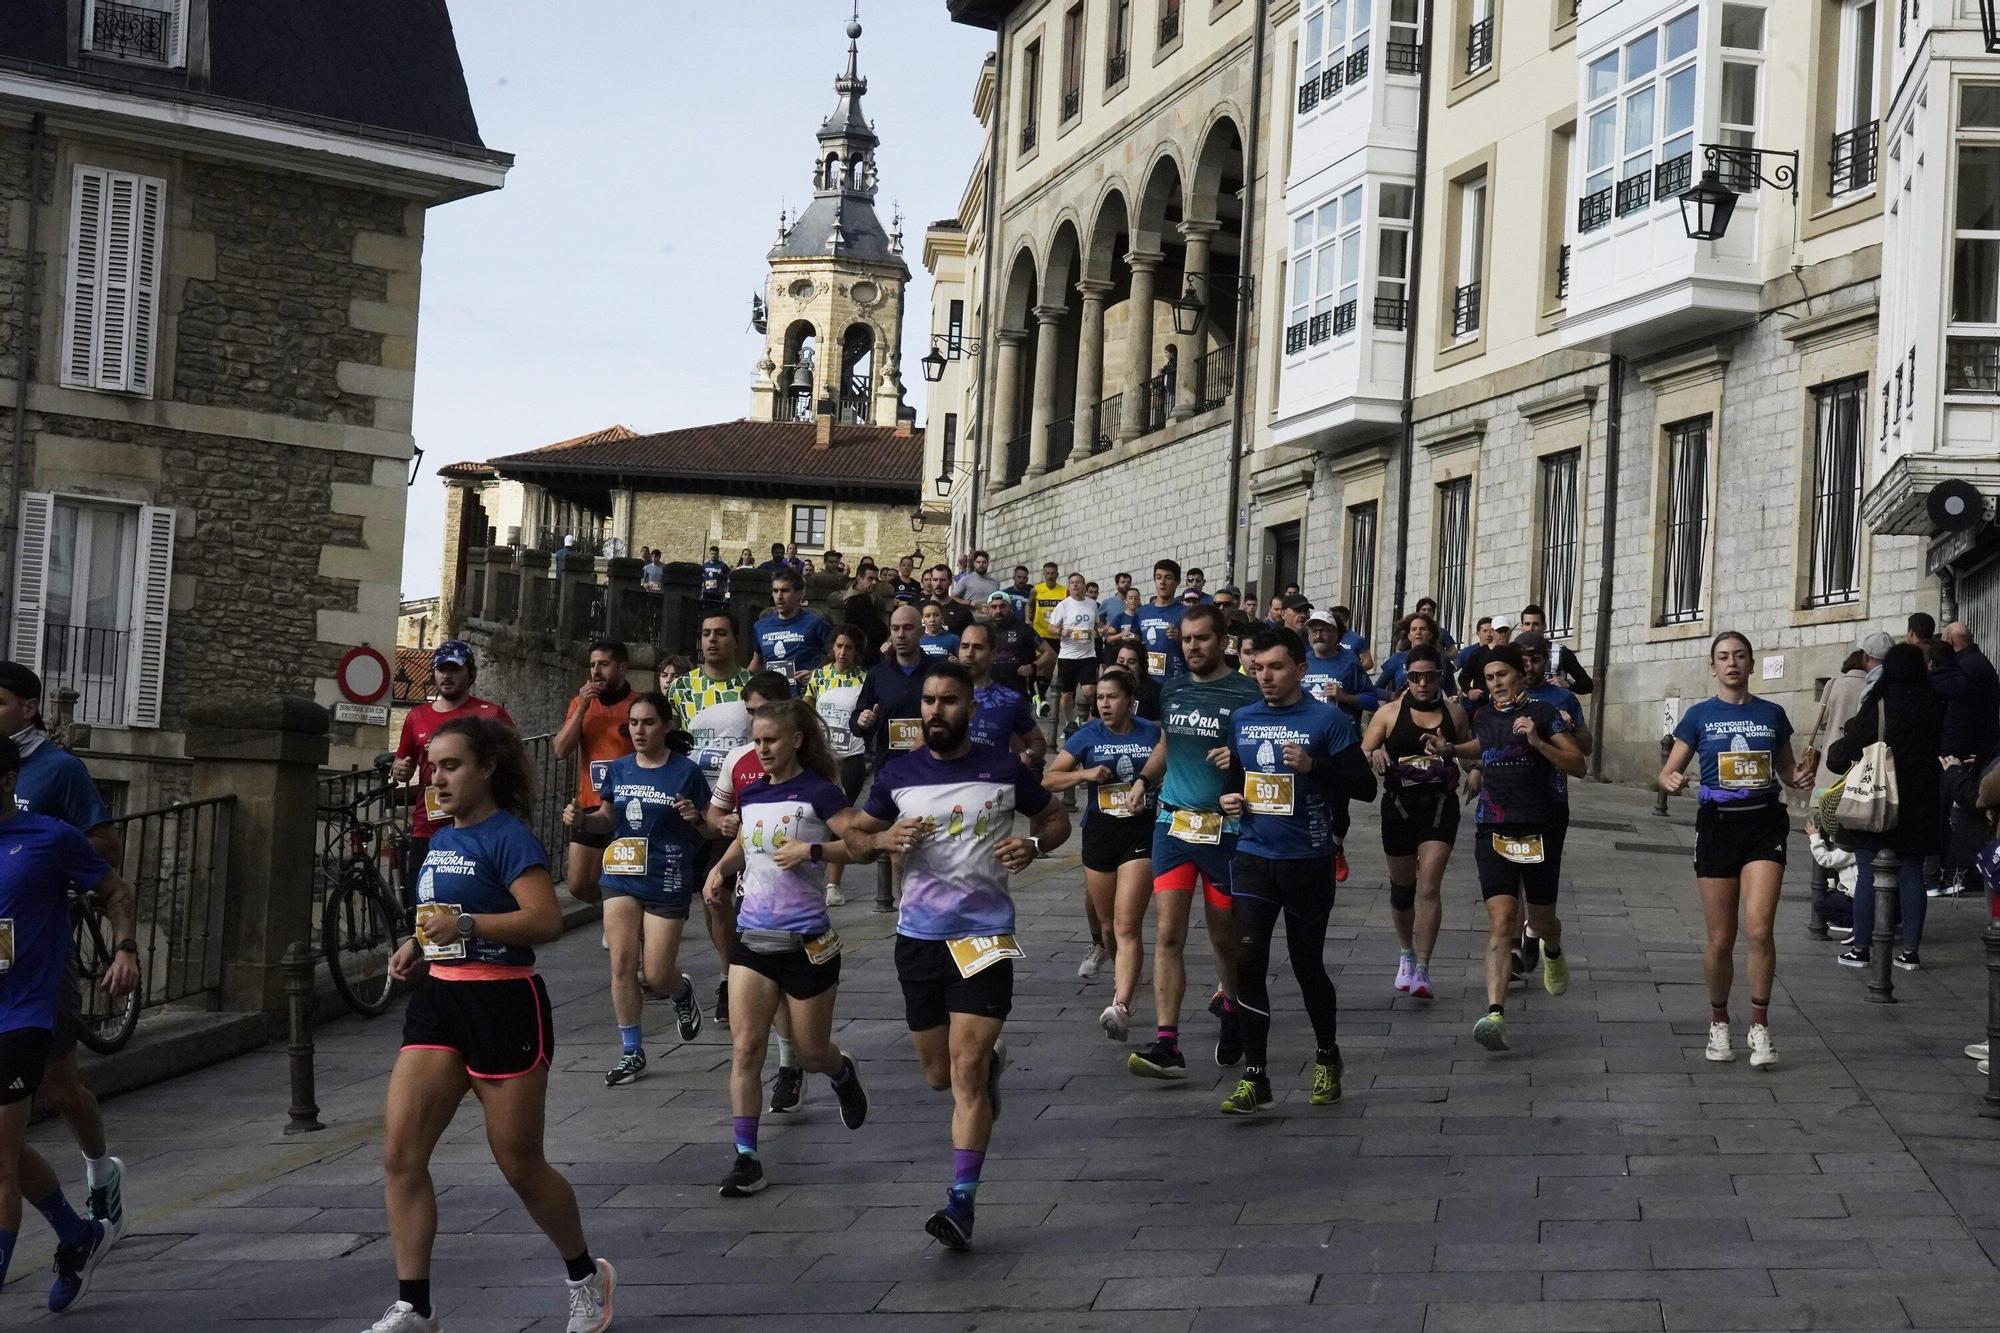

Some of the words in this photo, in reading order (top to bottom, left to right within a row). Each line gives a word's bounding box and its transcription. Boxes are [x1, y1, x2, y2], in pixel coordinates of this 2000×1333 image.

[1713, 720, 1755, 728] CONQUISTA
[900, 726, 918, 738] 510
[1196, 728, 1219, 738] TRAIL
[1716, 725, 1769, 734] ALMENDRA
[1248, 730, 1300, 740] ALMENDRA
[1103, 745, 1153, 755] ALMENDRA
[1734, 760, 1759, 776] 515
[620, 784, 656, 792] CONQUISTA
[1256, 783, 1280, 801] 597
[618, 789, 667, 799] ALMENDRA
[641, 797, 675, 807] KONKISTA
[613, 846, 636, 861] 585
[1505, 843, 1531, 854] 498
[435, 866, 476, 876] KONKISTA
